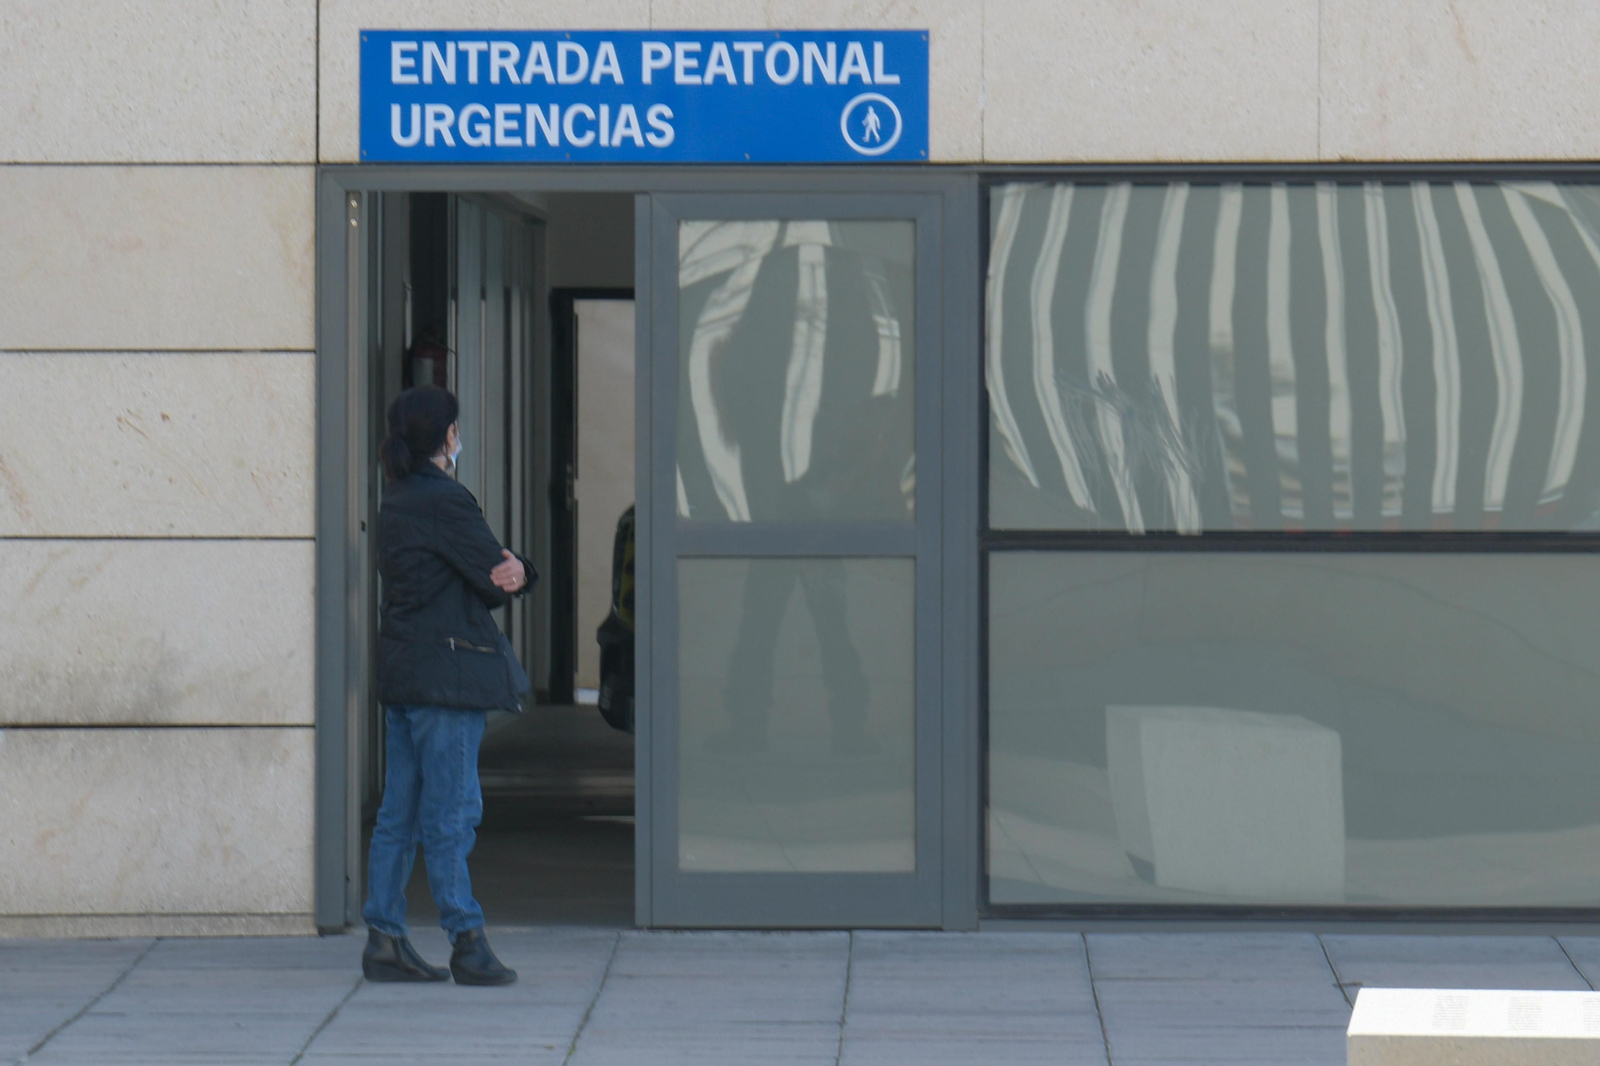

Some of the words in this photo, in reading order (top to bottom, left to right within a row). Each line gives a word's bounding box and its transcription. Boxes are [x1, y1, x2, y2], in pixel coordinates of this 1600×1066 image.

[391, 41, 624, 85] ENTRADA
[643, 41, 901, 85] PEATONAL
[391, 104, 675, 148] URGENCIAS
